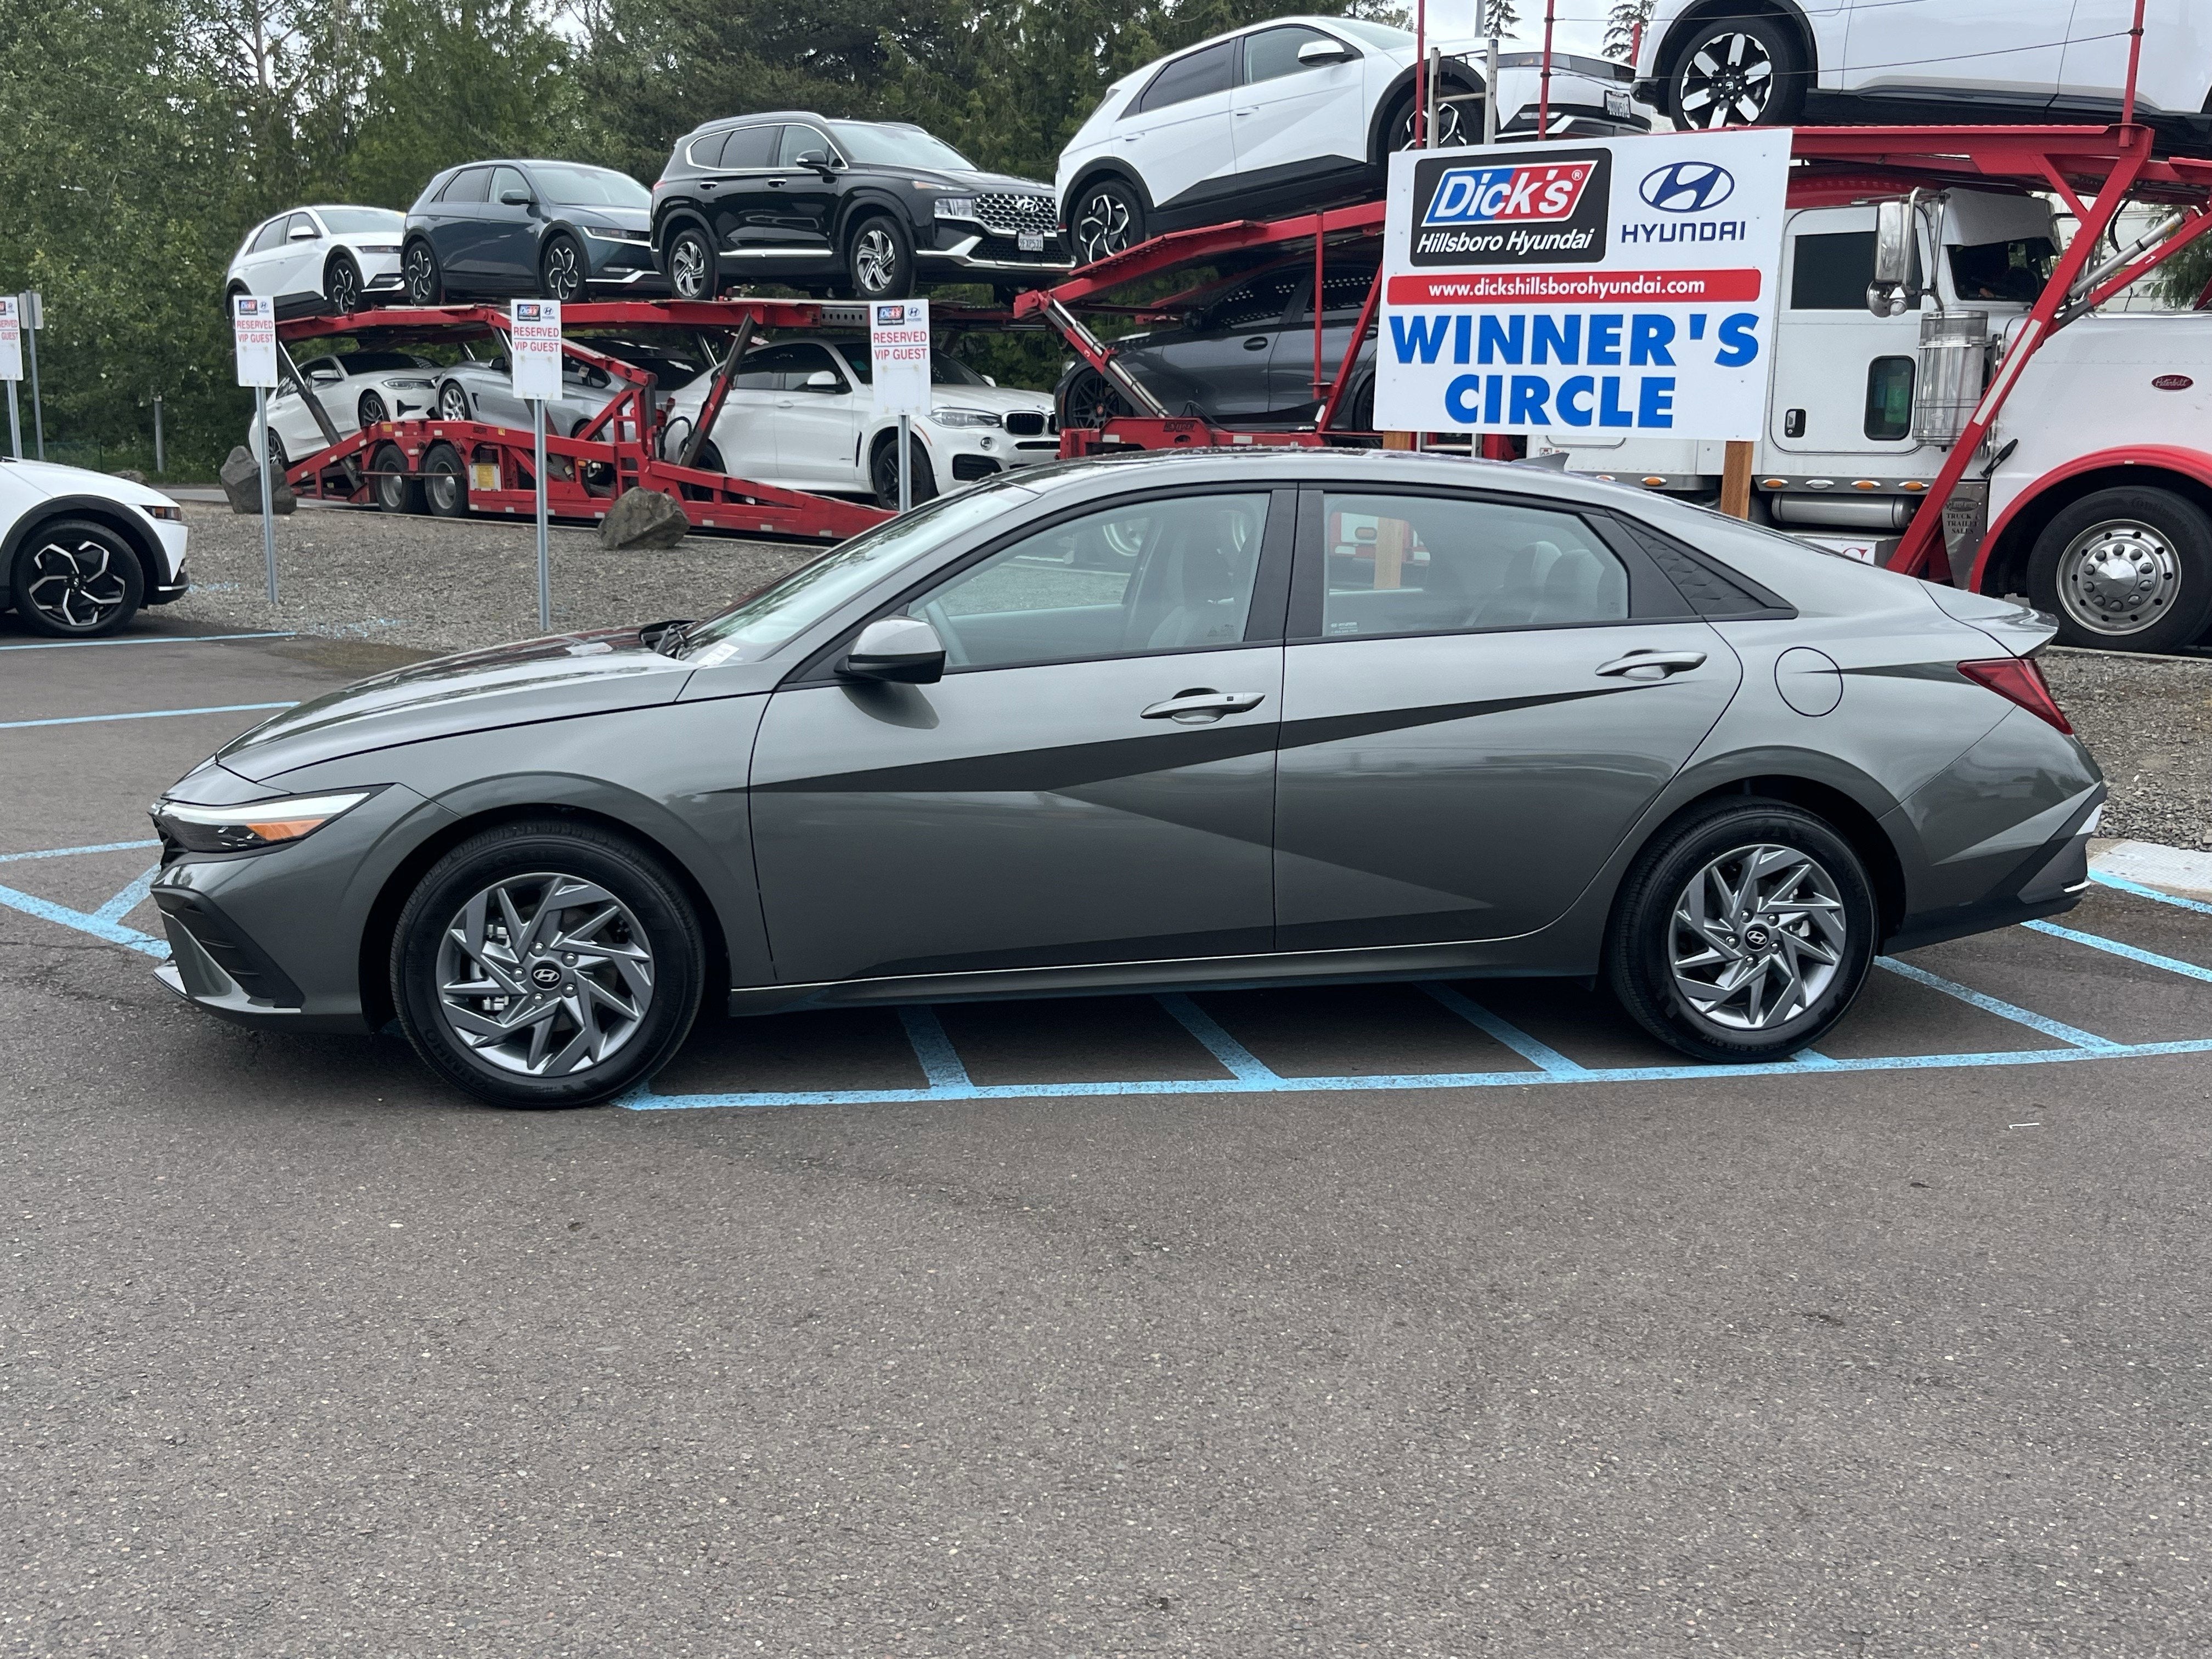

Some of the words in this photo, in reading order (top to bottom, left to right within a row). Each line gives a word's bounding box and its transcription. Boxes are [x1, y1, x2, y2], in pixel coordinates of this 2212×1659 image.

[1434, 169, 1573, 218] Dick's
[1621, 221, 1746, 243] HYUNDAI
[1416, 232, 1504, 253] Hillsboro
[1506, 229, 1595, 256] Hyundai
[1429, 276, 1705, 299] www.dickshillsborohyundai.com
[236, 320, 273, 329] RESERVED
[2, 331, 18, 340] GUEST
[514, 326, 560, 337] RESERVED
[873, 331, 927, 343] RESERVED
[238, 334, 249, 342] VIP
[250, 334, 273, 343] GUEST
[1389, 312, 1759, 368] WINNER'S
[514, 341, 527, 351] VIP
[531, 341, 559, 352] GUEST
[874, 349, 890, 360] VIP
[893, 348, 927, 360] GUEST
[2155, 377, 2190, 387] Peterbilt
[1444, 374, 1675, 428] CIRCLE
